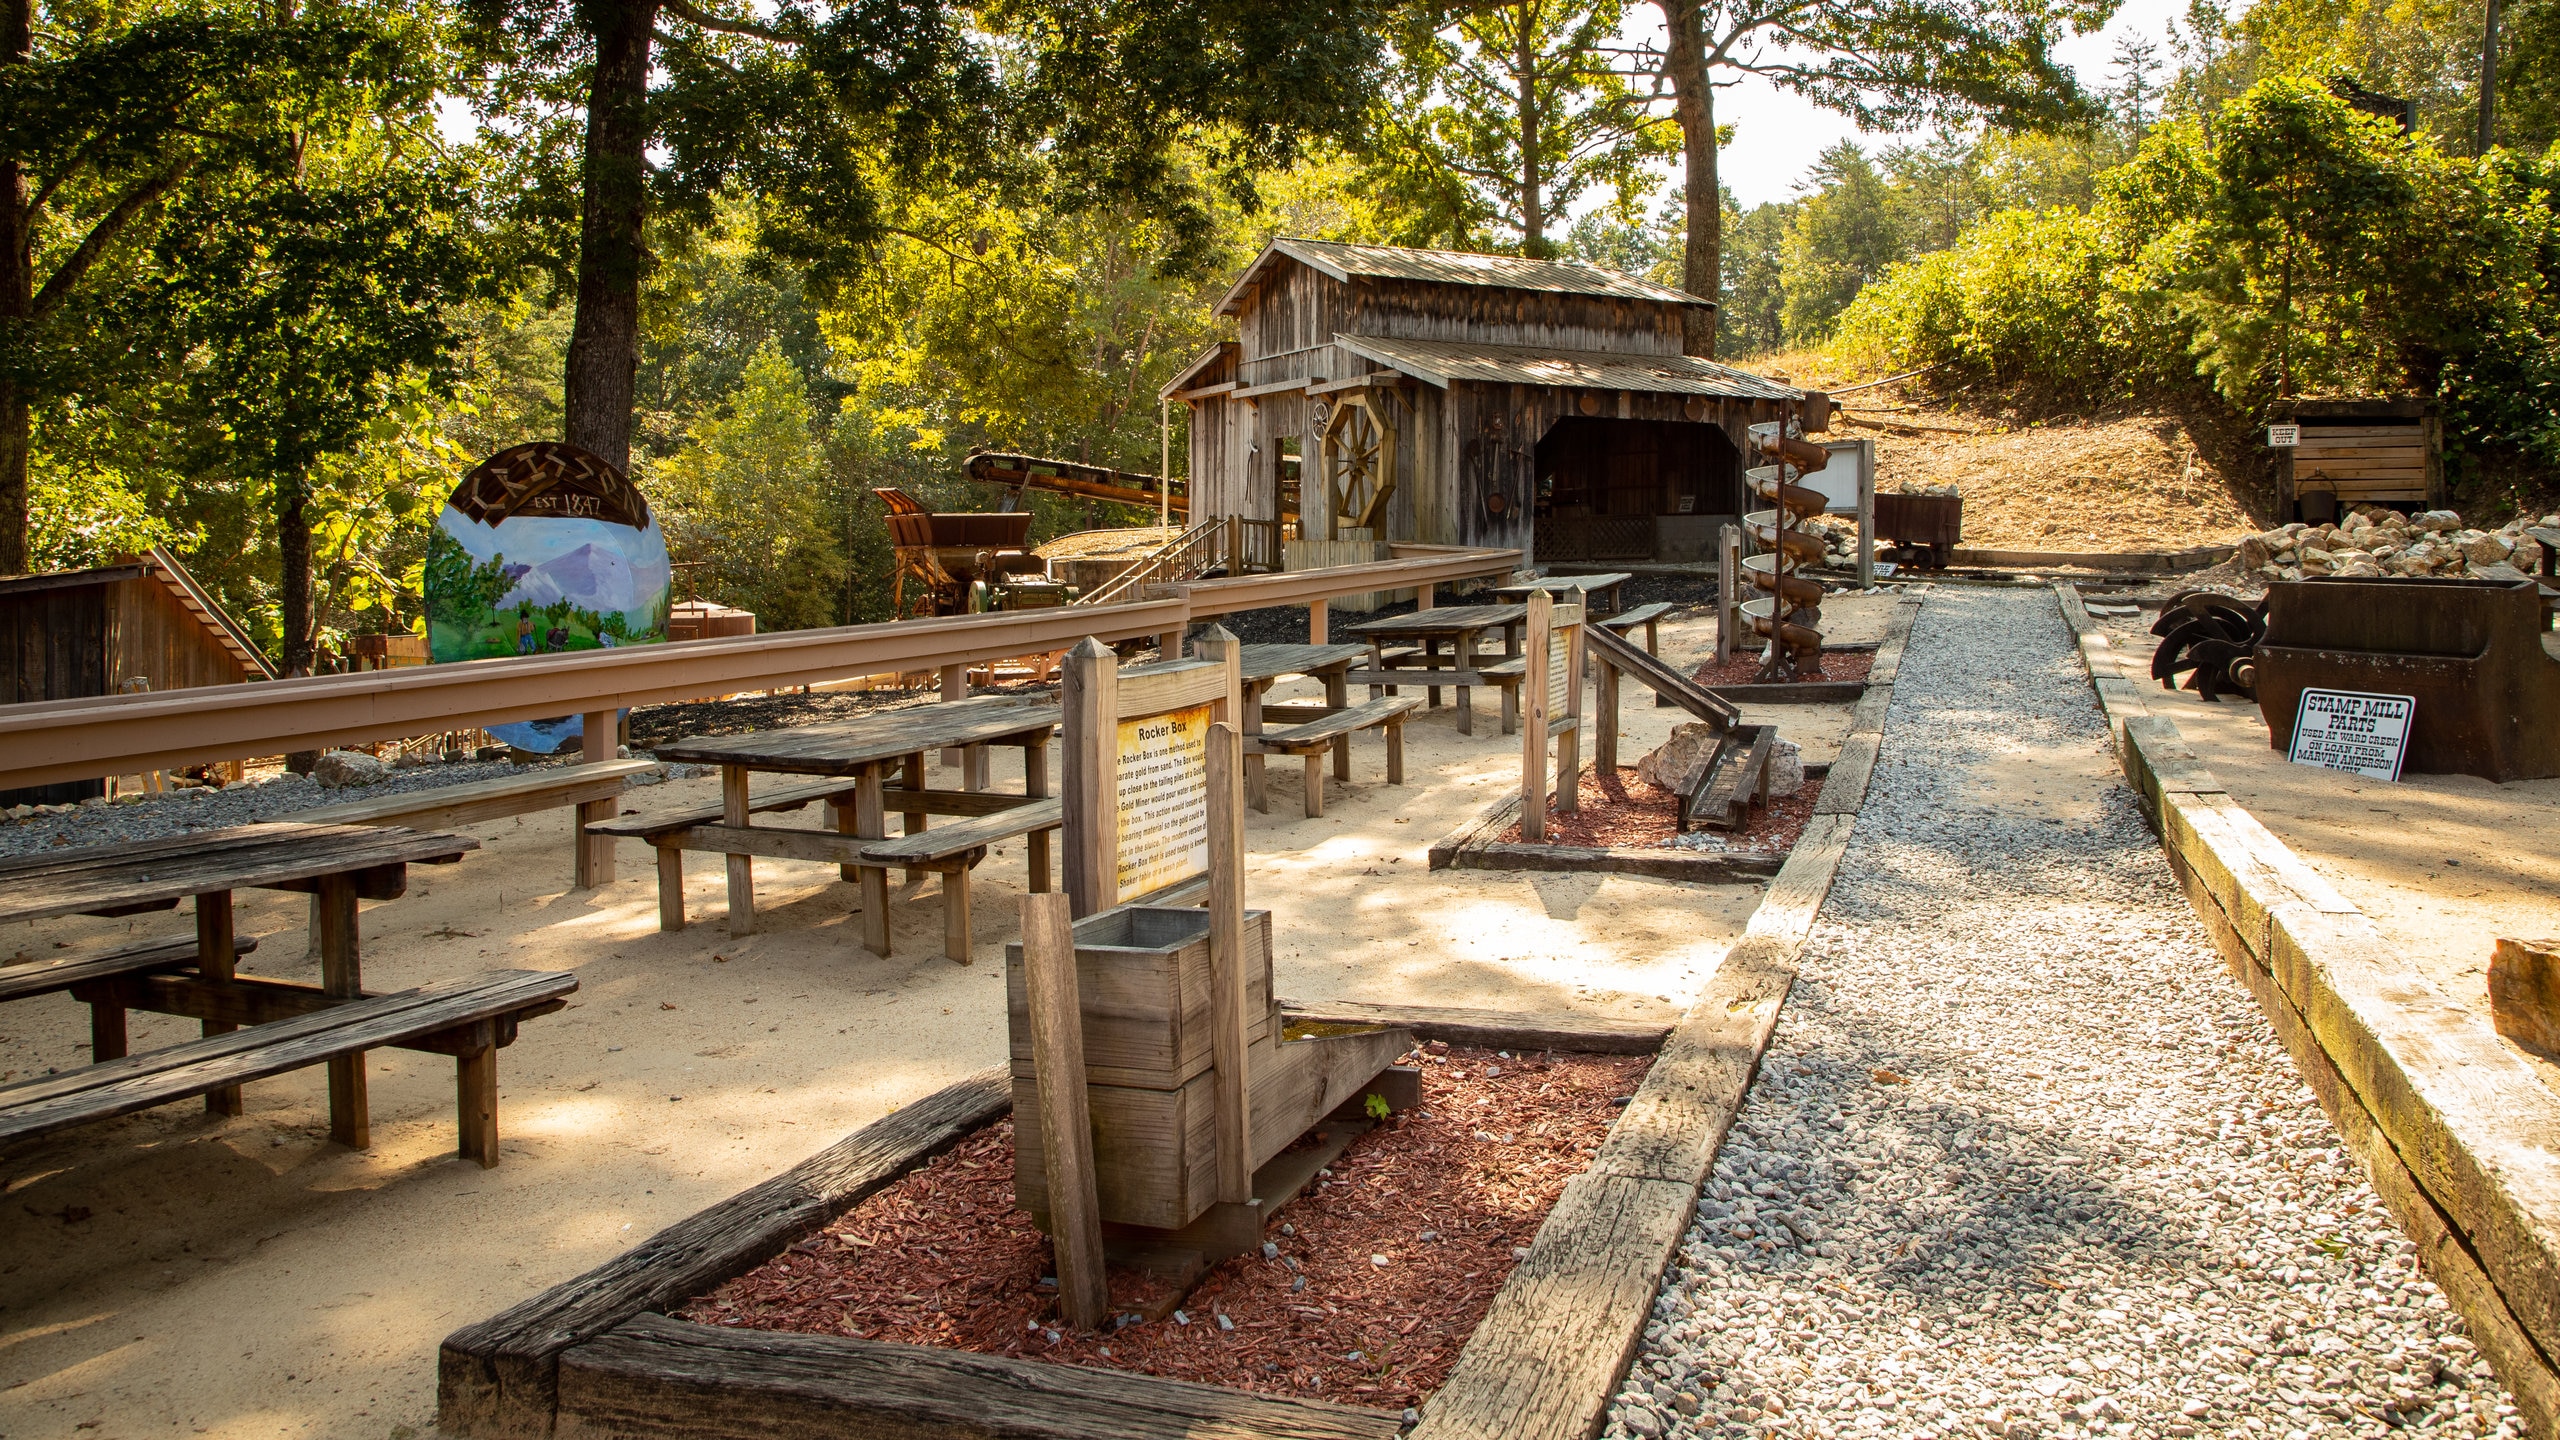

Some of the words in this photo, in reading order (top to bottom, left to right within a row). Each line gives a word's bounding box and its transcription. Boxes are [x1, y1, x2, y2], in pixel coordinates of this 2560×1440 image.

[2272, 428, 2296, 436] KEEP
[471, 446, 640, 522] CRISSON
[534, 496, 558, 509] EST
[564, 493, 600, 516] 1847
[2308, 696, 2360, 715] STAMP
[2362, 700, 2403, 719] MILL
[1139, 725, 1169, 741] Rocker
[1172, 722, 1187, 734] Box
[2328, 714, 2376, 732] PARTS
[2302, 728, 2323, 738] USED
[2325, 731, 2338, 740] AT
[2340, 732, 2366, 744] WARD
[2368, 736, 2399, 746] CREEK
[1123, 753, 1141, 764] Rocker
[1143, 750, 1152, 760] Box
[1154, 748, 1158, 757] is
[1160, 748, 1168, 756] one
[1169, 742, 1185, 753] method
[1186, 739, 1195, 749] used
[2297, 750, 2339, 763] MARVIN
[2340, 755, 2392, 770] ANDERSON
[2309, 742, 2322, 750] ON
[2324, 742, 2352, 754] LOAN
[2354, 746, 2385, 758] FROM
[1117, 771, 1133, 781] arate
[1135, 767, 1146, 779] gold
[1148, 765, 1159, 774] from
[1174, 758, 1182, 767] The
[1183, 756, 1191, 765] Box
[1192, 752, 1203, 761] would
[1119, 788, 1126, 797] up
[1128, 784, 1142, 794] close
[1143, 782, 1148, 790] to
[1159, 776, 1173, 786] tailing
[1174, 772, 1184, 784] piles
[1193, 767, 1201, 776] Gold
[1121, 800, 1134, 811] Gold
[1136, 798, 1150, 808] Miner
[1151, 792, 1165, 803] would
[1166, 791, 1176, 801] pour
[1177, 786, 1188, 796] water
[1121, 817, 1130, 827] the
[1144, 811, 1154, 820] This
[1156, 806, 1170, 817] action
[1172, 802, 1184, 812] would
[1122, 830, 1141, 842] bearing
[1143, 822, 1163, 836] material
[1179, 814, 1188, 826] gold
[1189, 810, 1199, 821] could
[1118, 849, 1127, 860] ght
[1128, 847, 1133, 855] in
[1135, 844, 1143, 853] the
[1162, 836, 1170, 845] The
[1171, 830, 1187, 841] modern
[1188, 824, 1202, 834] version
[1118, 860, 1137, 874] Rocker
[1138, 858, 1147, 867] Box
[1149, 854, 1159, 863] that
[1160, 852, 1164, 860] is
[1165, 848, 1176, 858] used
[1177, 844, 1189, 854] today
[1120, 876, 1138, 888] Shaker
[1139, 871, 1151, 882] table
[1163, 862, 1175, 872] wash
